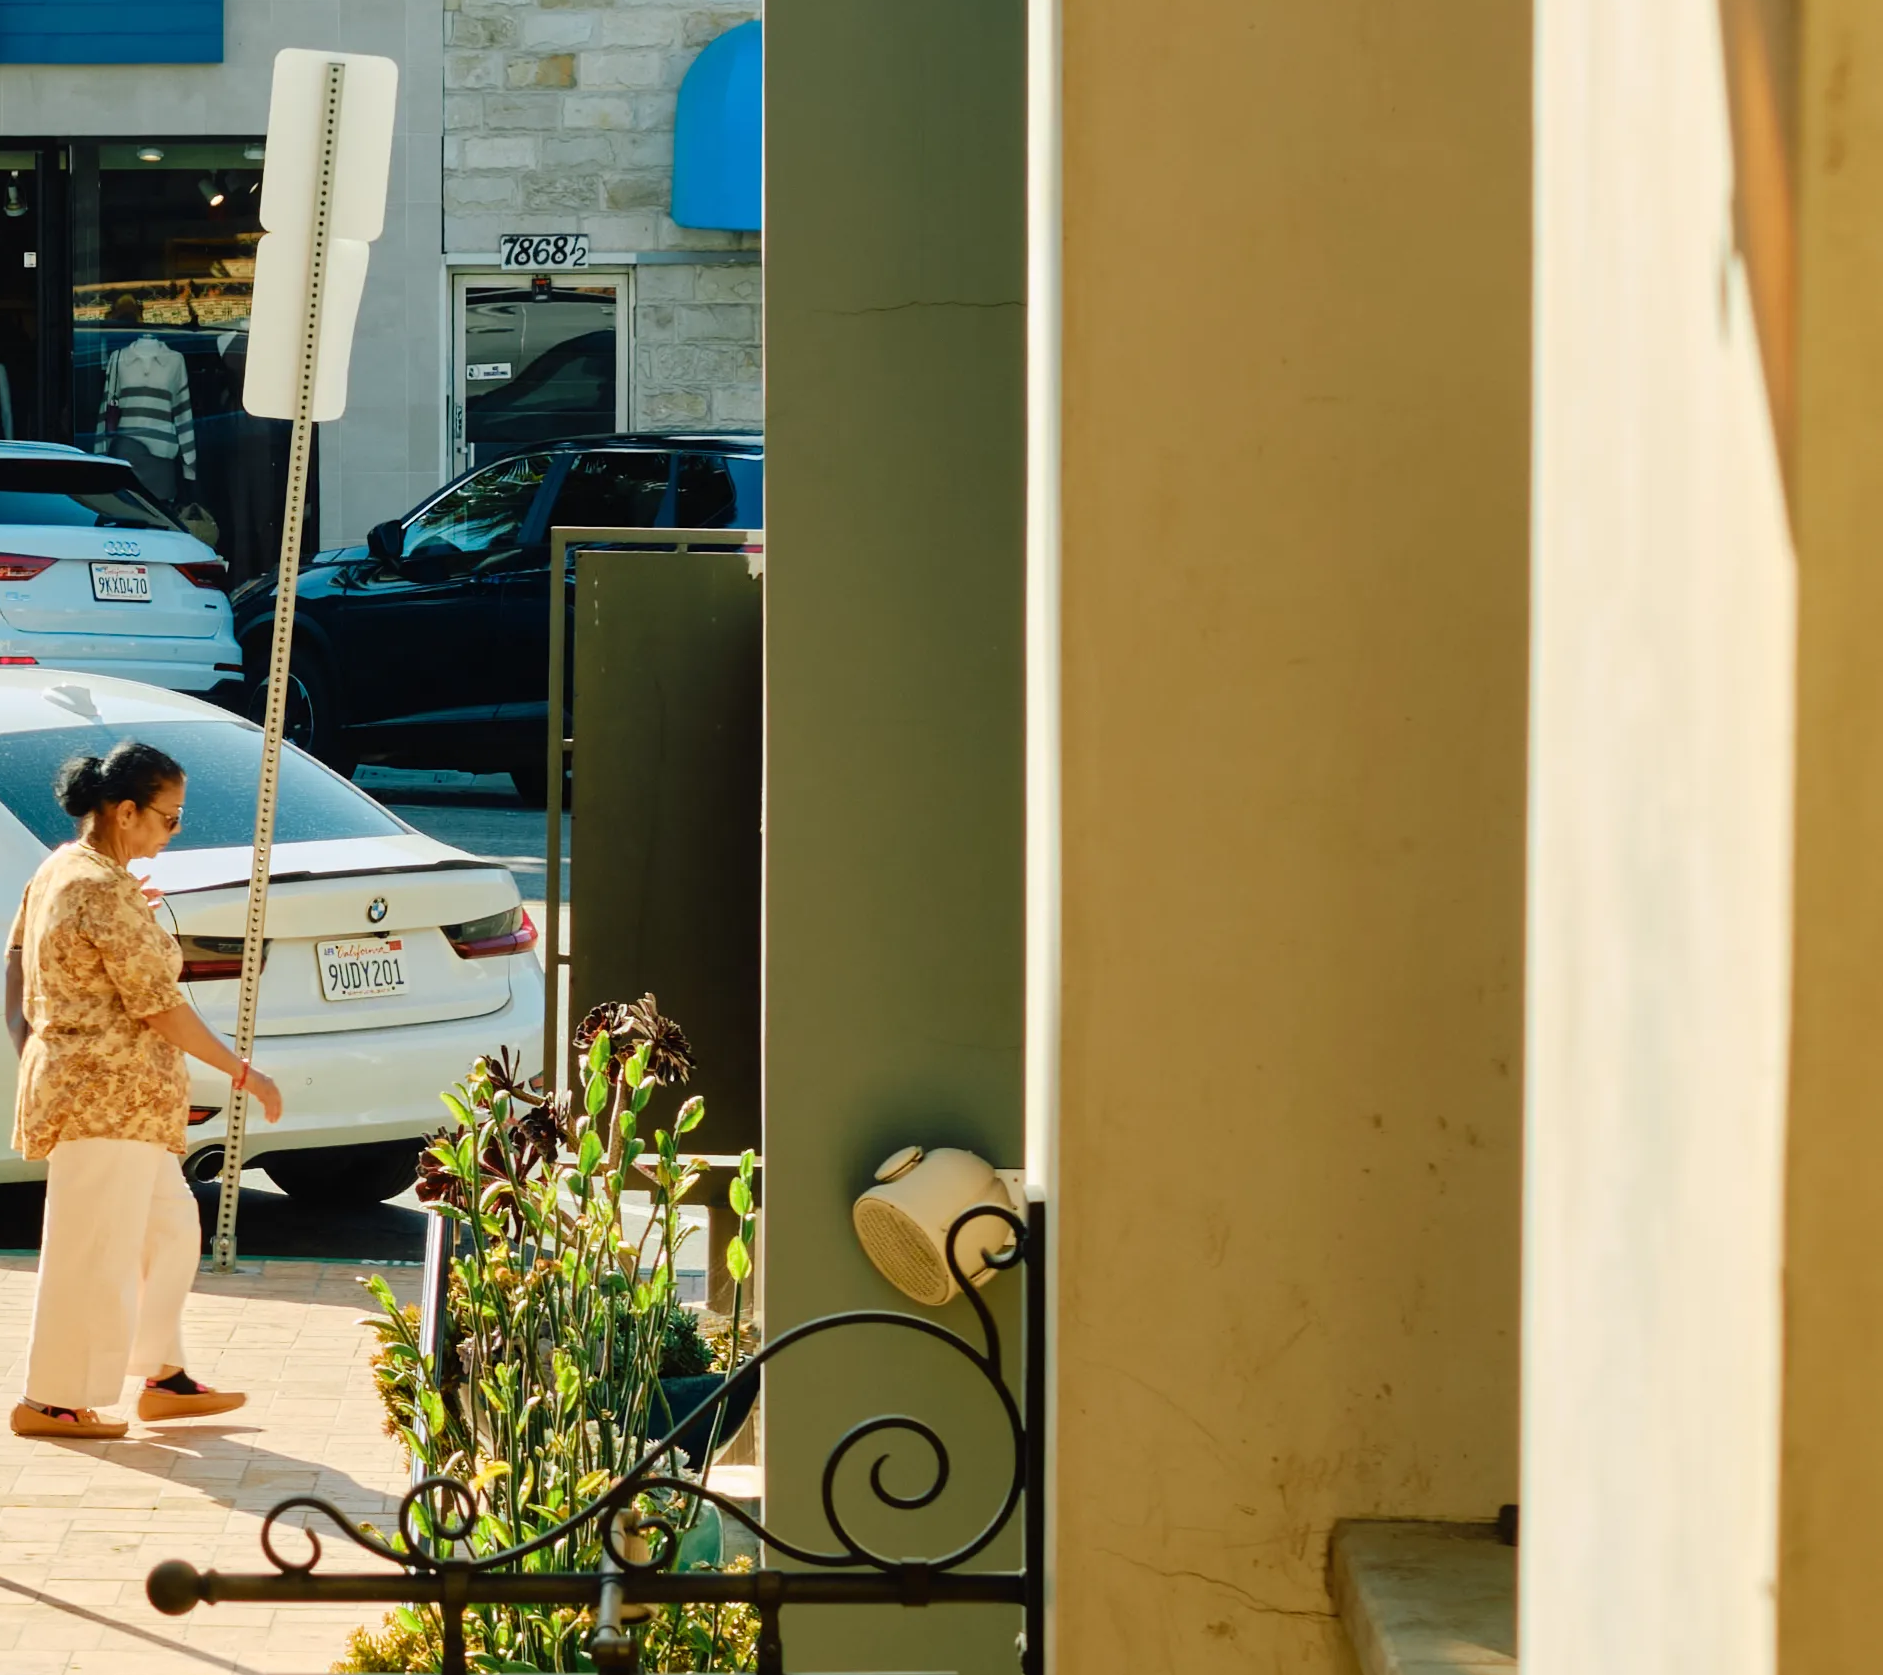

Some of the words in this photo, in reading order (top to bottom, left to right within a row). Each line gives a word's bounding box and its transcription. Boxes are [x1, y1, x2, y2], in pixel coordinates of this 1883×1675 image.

[98, 576, 148, 595] 9KXD470
[337, 944, 390, 961] California
[328, 958, 405, 991] 9UDY201
